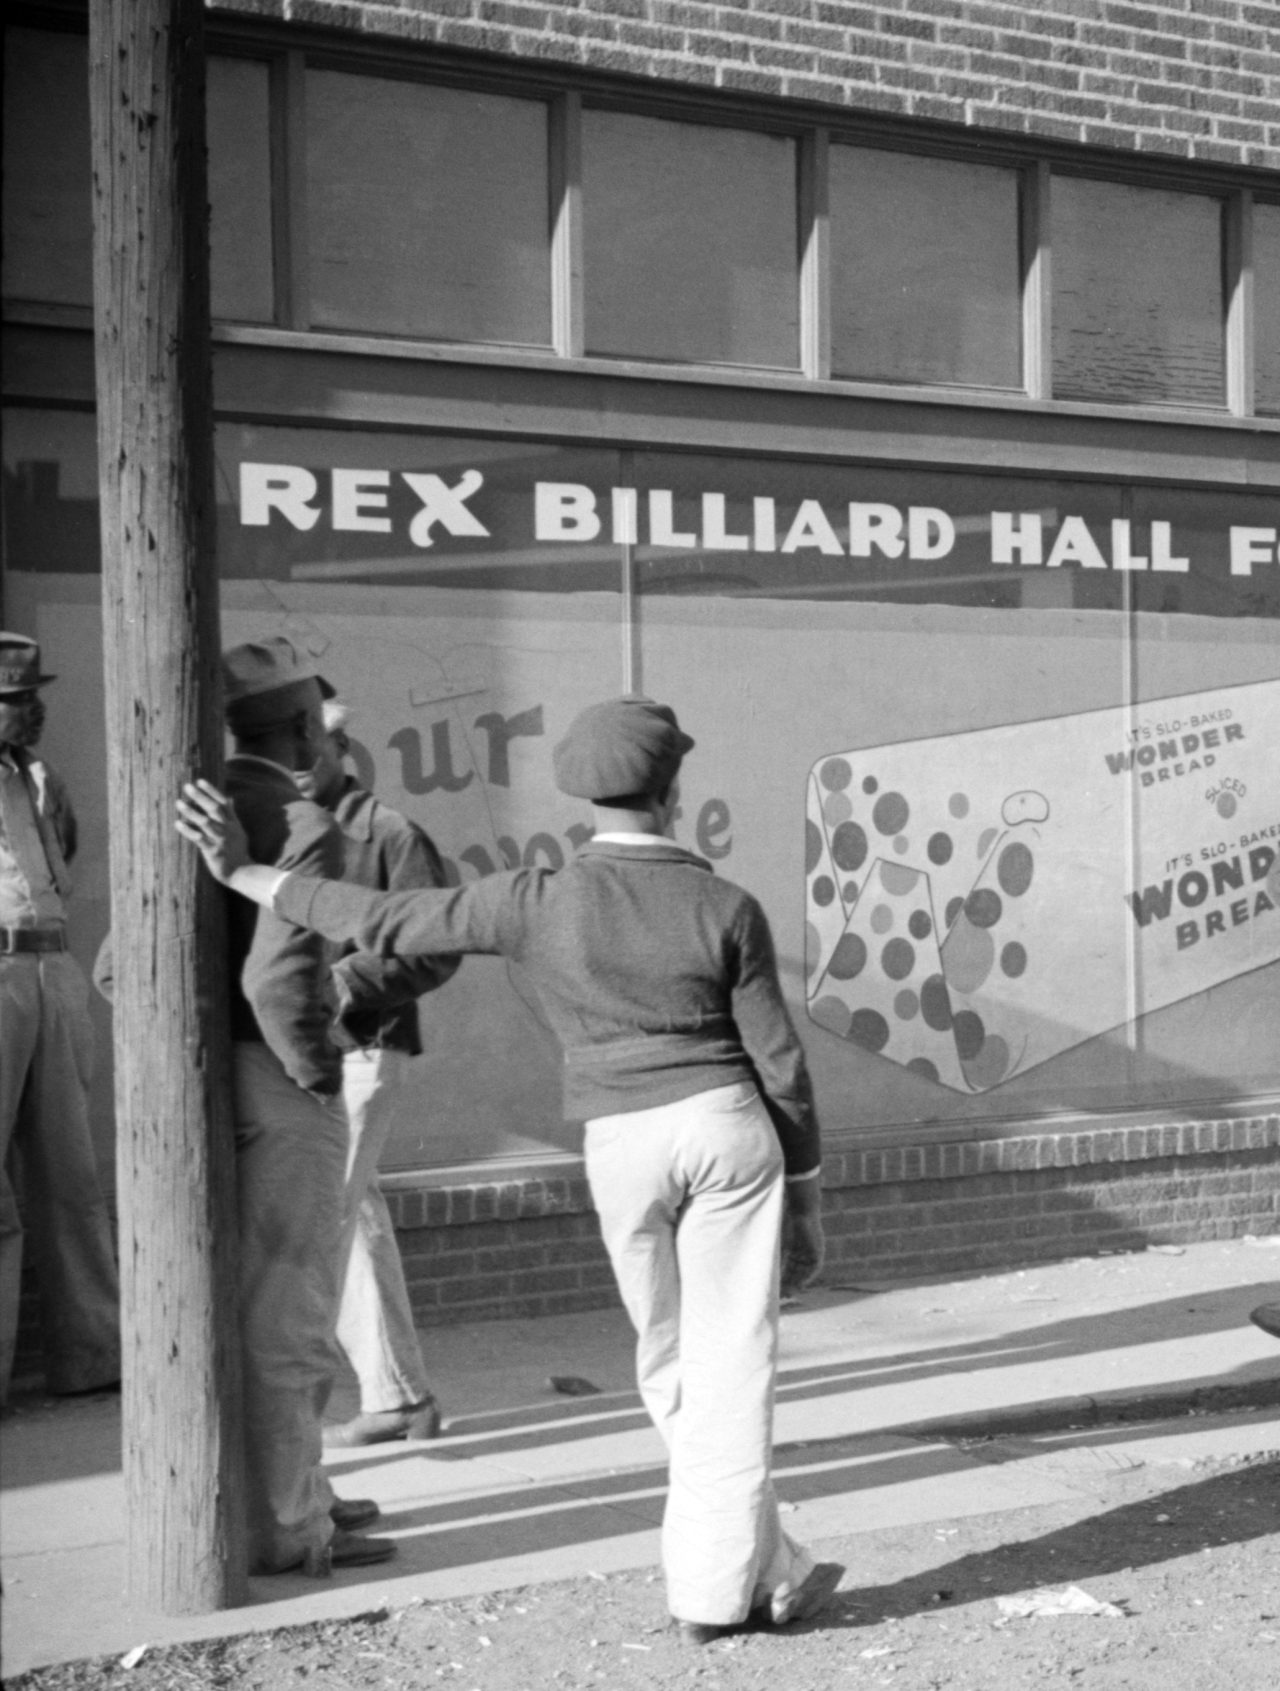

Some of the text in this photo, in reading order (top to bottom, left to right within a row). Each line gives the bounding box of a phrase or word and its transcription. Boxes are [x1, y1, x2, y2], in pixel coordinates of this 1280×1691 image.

[239, 462, 491, 548] REX
[535, 481, 956, 560] BILLIARD
[990, 512, 1189, 572] HALL
[1105, 723, 1245, 775] WONDER
[1140, 754, 1216, 787] BREAD
[1205, 777, 1247, 804] SLICED
[1125, 844, 1277, 928] WOND
[1166, 853, 1193, 873] IT'S
[1176, 891, 1275, 950] BREA
